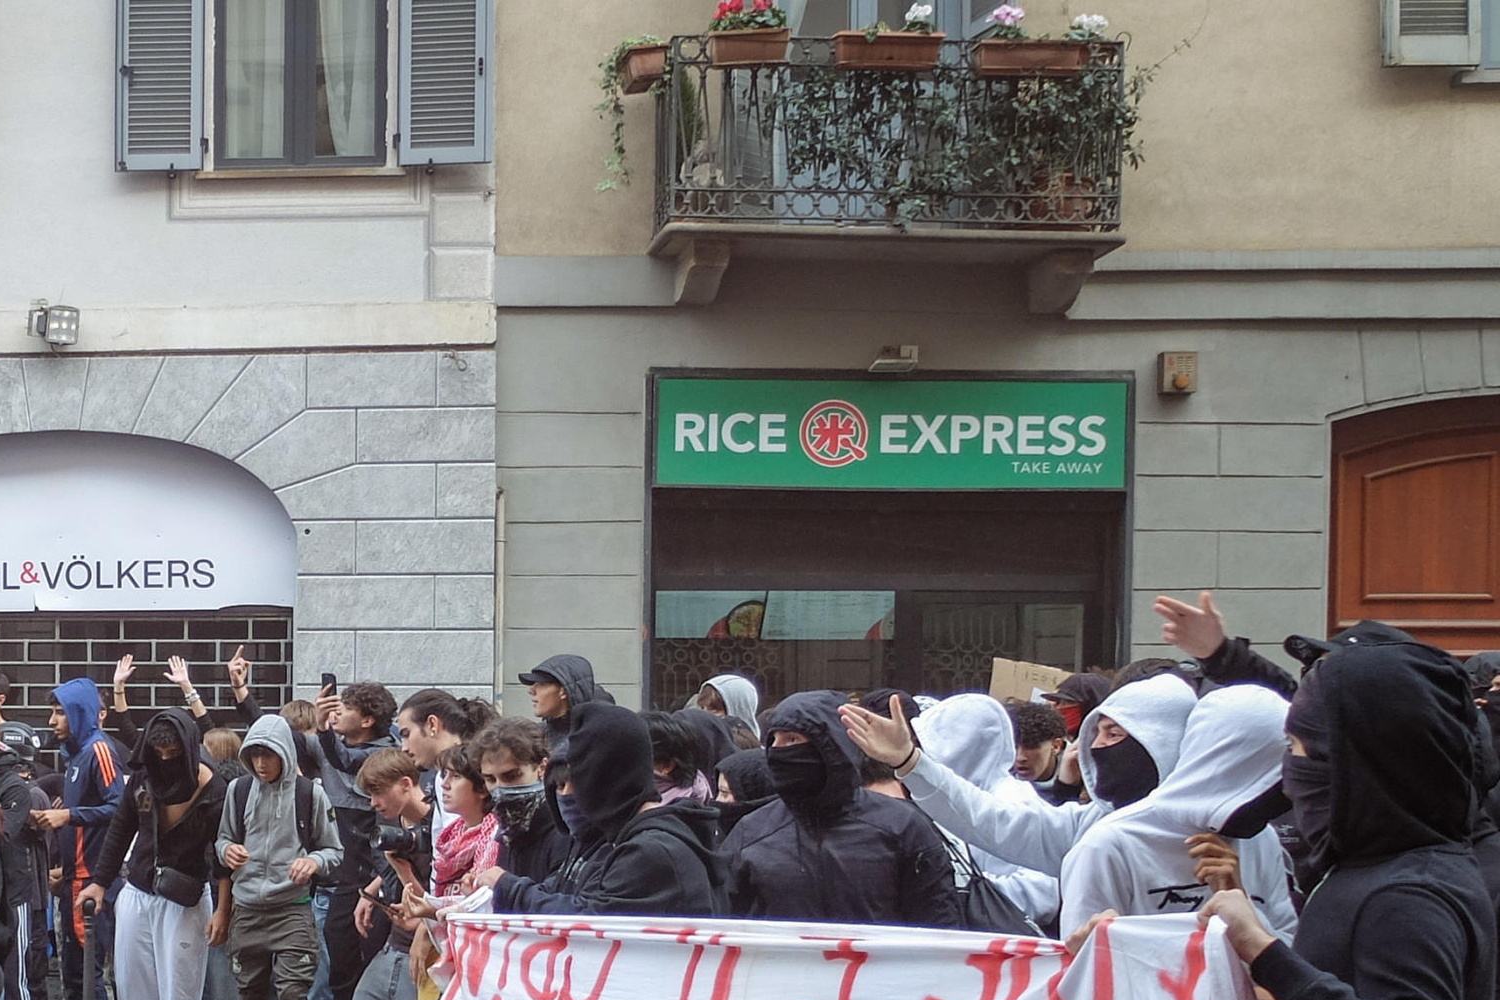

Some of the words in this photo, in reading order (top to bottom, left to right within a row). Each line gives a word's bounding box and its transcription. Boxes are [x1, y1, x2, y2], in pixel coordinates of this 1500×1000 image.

[674, 413, 787, 453] RICE
[880, 415, 1106, 456] EXPRESS
[1011, 461, 1051, 474] TAKE
[1056, 461, 1103, 474] AWAY
